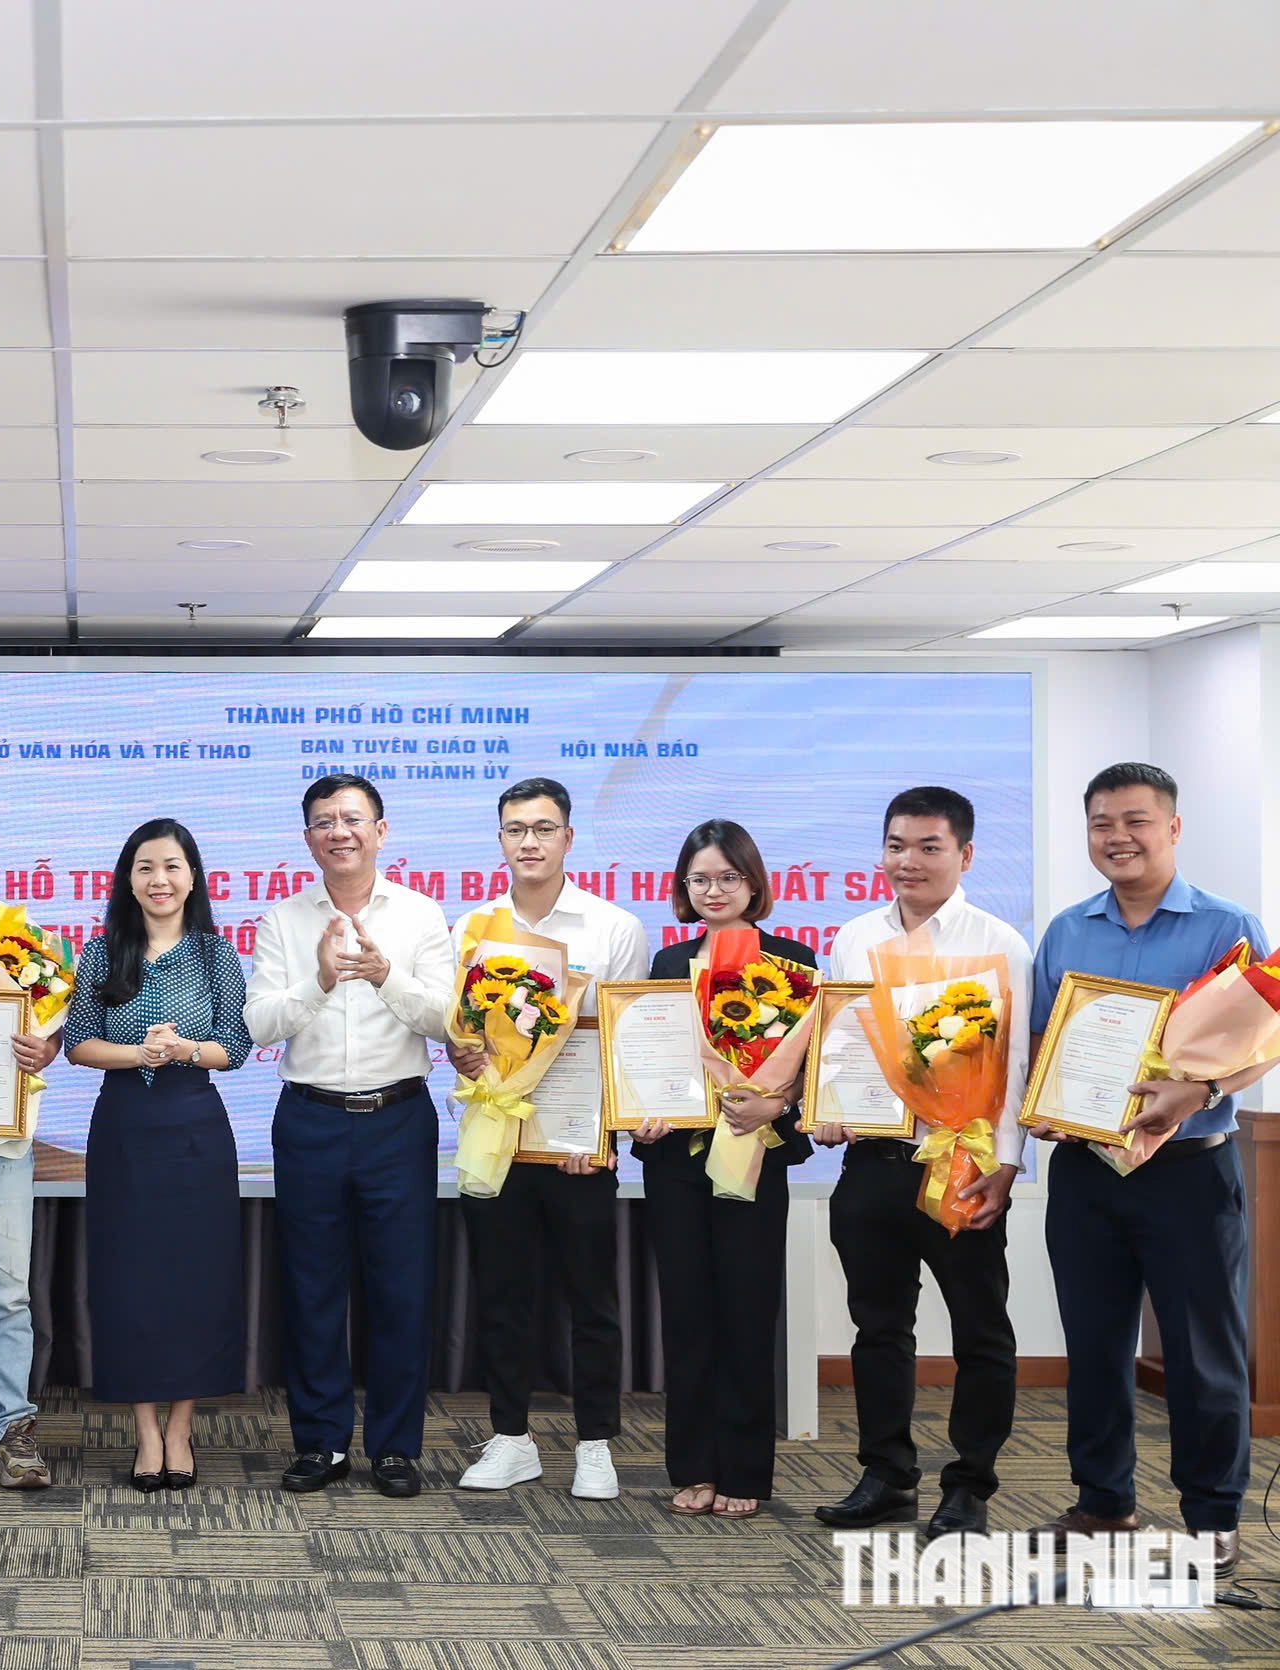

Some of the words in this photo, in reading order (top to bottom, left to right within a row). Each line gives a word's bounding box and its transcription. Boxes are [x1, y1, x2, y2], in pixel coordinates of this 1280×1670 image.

[225, 703, 305, 724] THÀNH
[315, 702, 365, 724] PHỐ
[372, 702, 404, 724] HỒ
[412, 703, 454, 724] CHÍ
[461, 707, 530, 724] MINH
[18, 741, 62, 759] VĂN
[70, 740, 111, 759] HÓA
[120, 740, 146, 759] VÀ
[153, 738, 193, 759] THỂ
[196, 744, 251, 759] THAO
[300, 739, 344, 754] BAN
[351, 737, 418, 754] TUYÊN
[426, 736, 476, 754] GIÁO
[484, 736, 510, 754] VÀ
[560, 740, 596, 760] HỘI
[604, 739, 649, 758] NHÀ
[657, 739, 699, 758] BÁO
[353, 762, 397, 781] VẬN
[404, 761, 475, 780] THÀNH
[484, 760, 510, 780] ỦY
[5, 858, 54, 900] HỖ
[69, 870, 115, 900] TR
[461, 862, 509, 901] BÁ
[631, 871, 677, 902] HA
